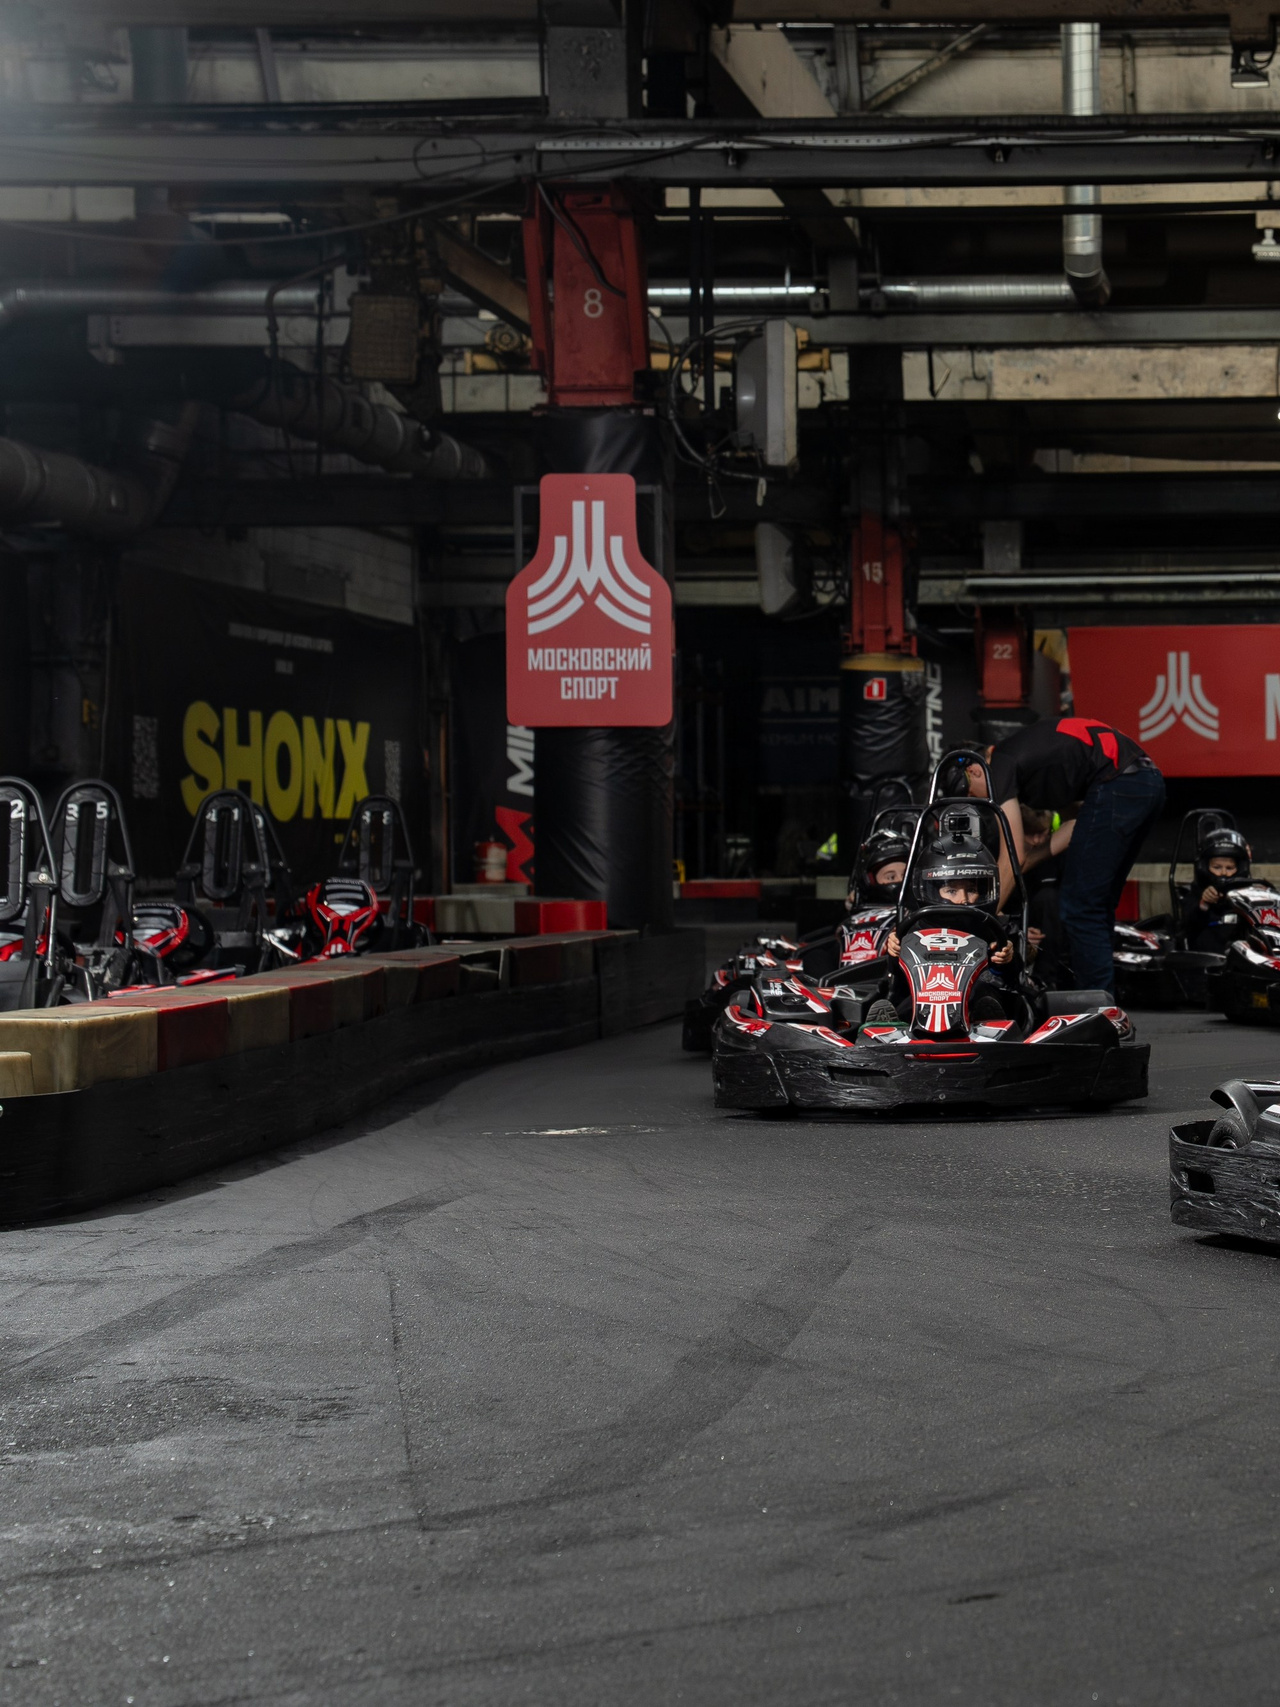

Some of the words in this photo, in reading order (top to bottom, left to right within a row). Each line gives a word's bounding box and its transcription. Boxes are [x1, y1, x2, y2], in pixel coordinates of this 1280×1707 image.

[582, 288, 605, 319] 8
[527, 642, 652, 672] МОСКОВСКИЙ
[993, 643, 1013, 660] 22
[560, 677, 620, 700] СПОРТ
[180, 700, 371, 823] SHONX
